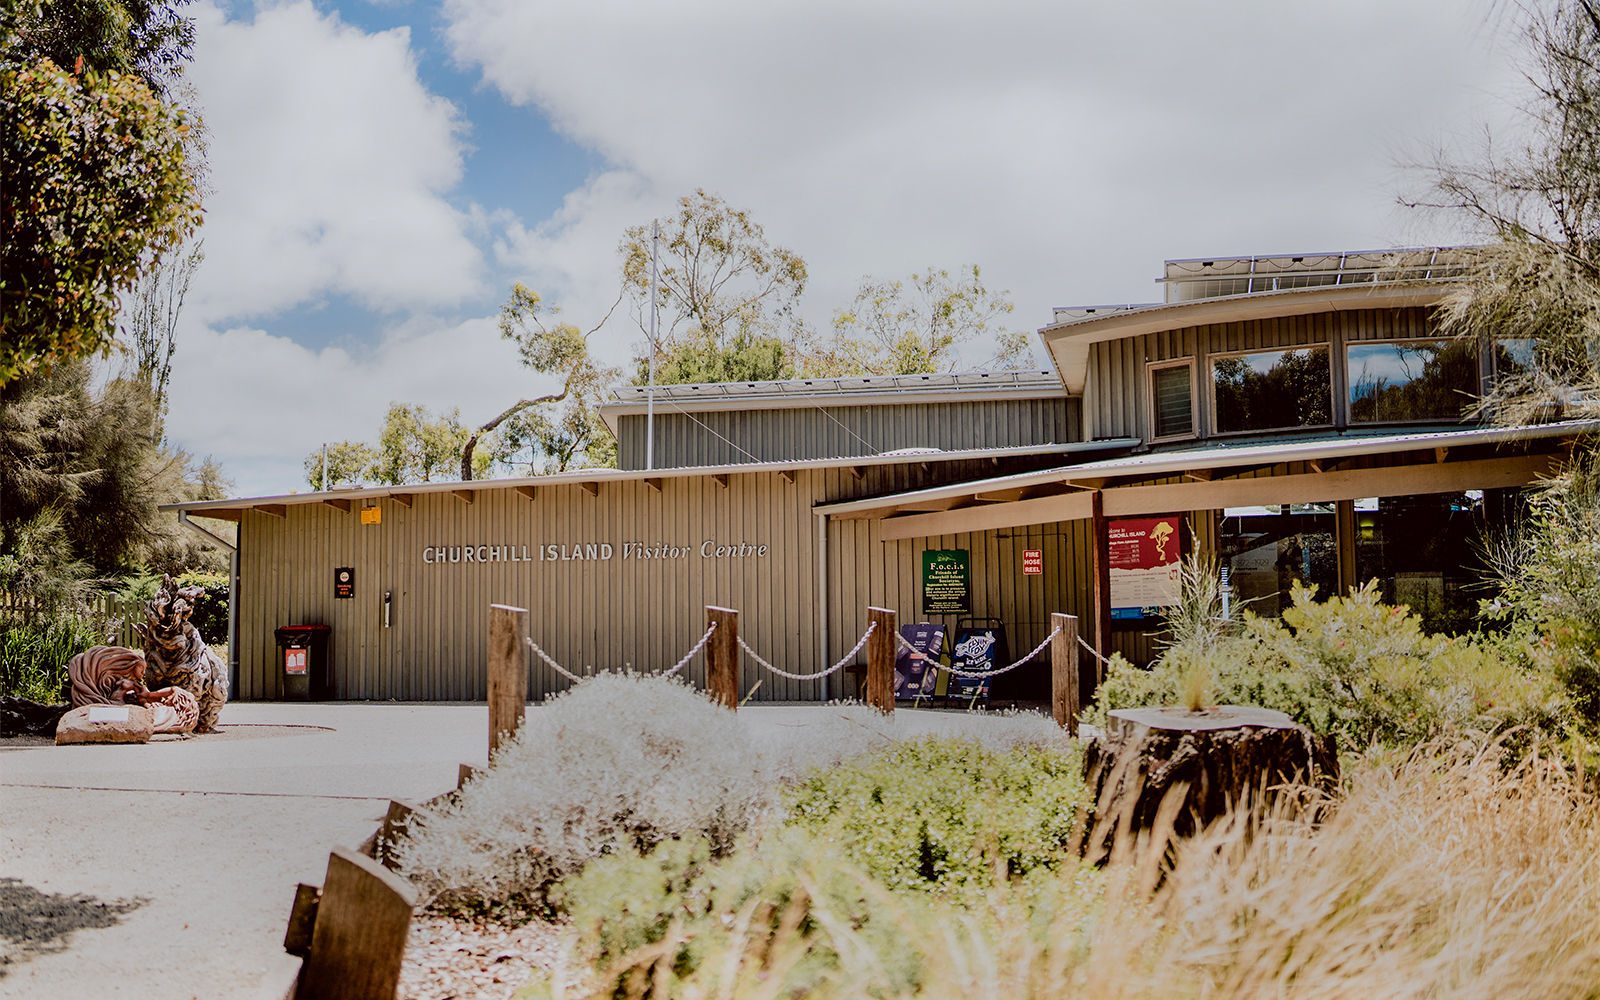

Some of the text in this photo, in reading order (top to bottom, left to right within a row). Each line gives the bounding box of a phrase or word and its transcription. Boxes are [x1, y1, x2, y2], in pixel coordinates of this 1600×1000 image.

[423, 540, 768, 563] CHURCHILL ISLAND Visitor Centre
[930, 562, 964, 570] F.o.c.i.s
[971, 645, 984, 654] FOX
